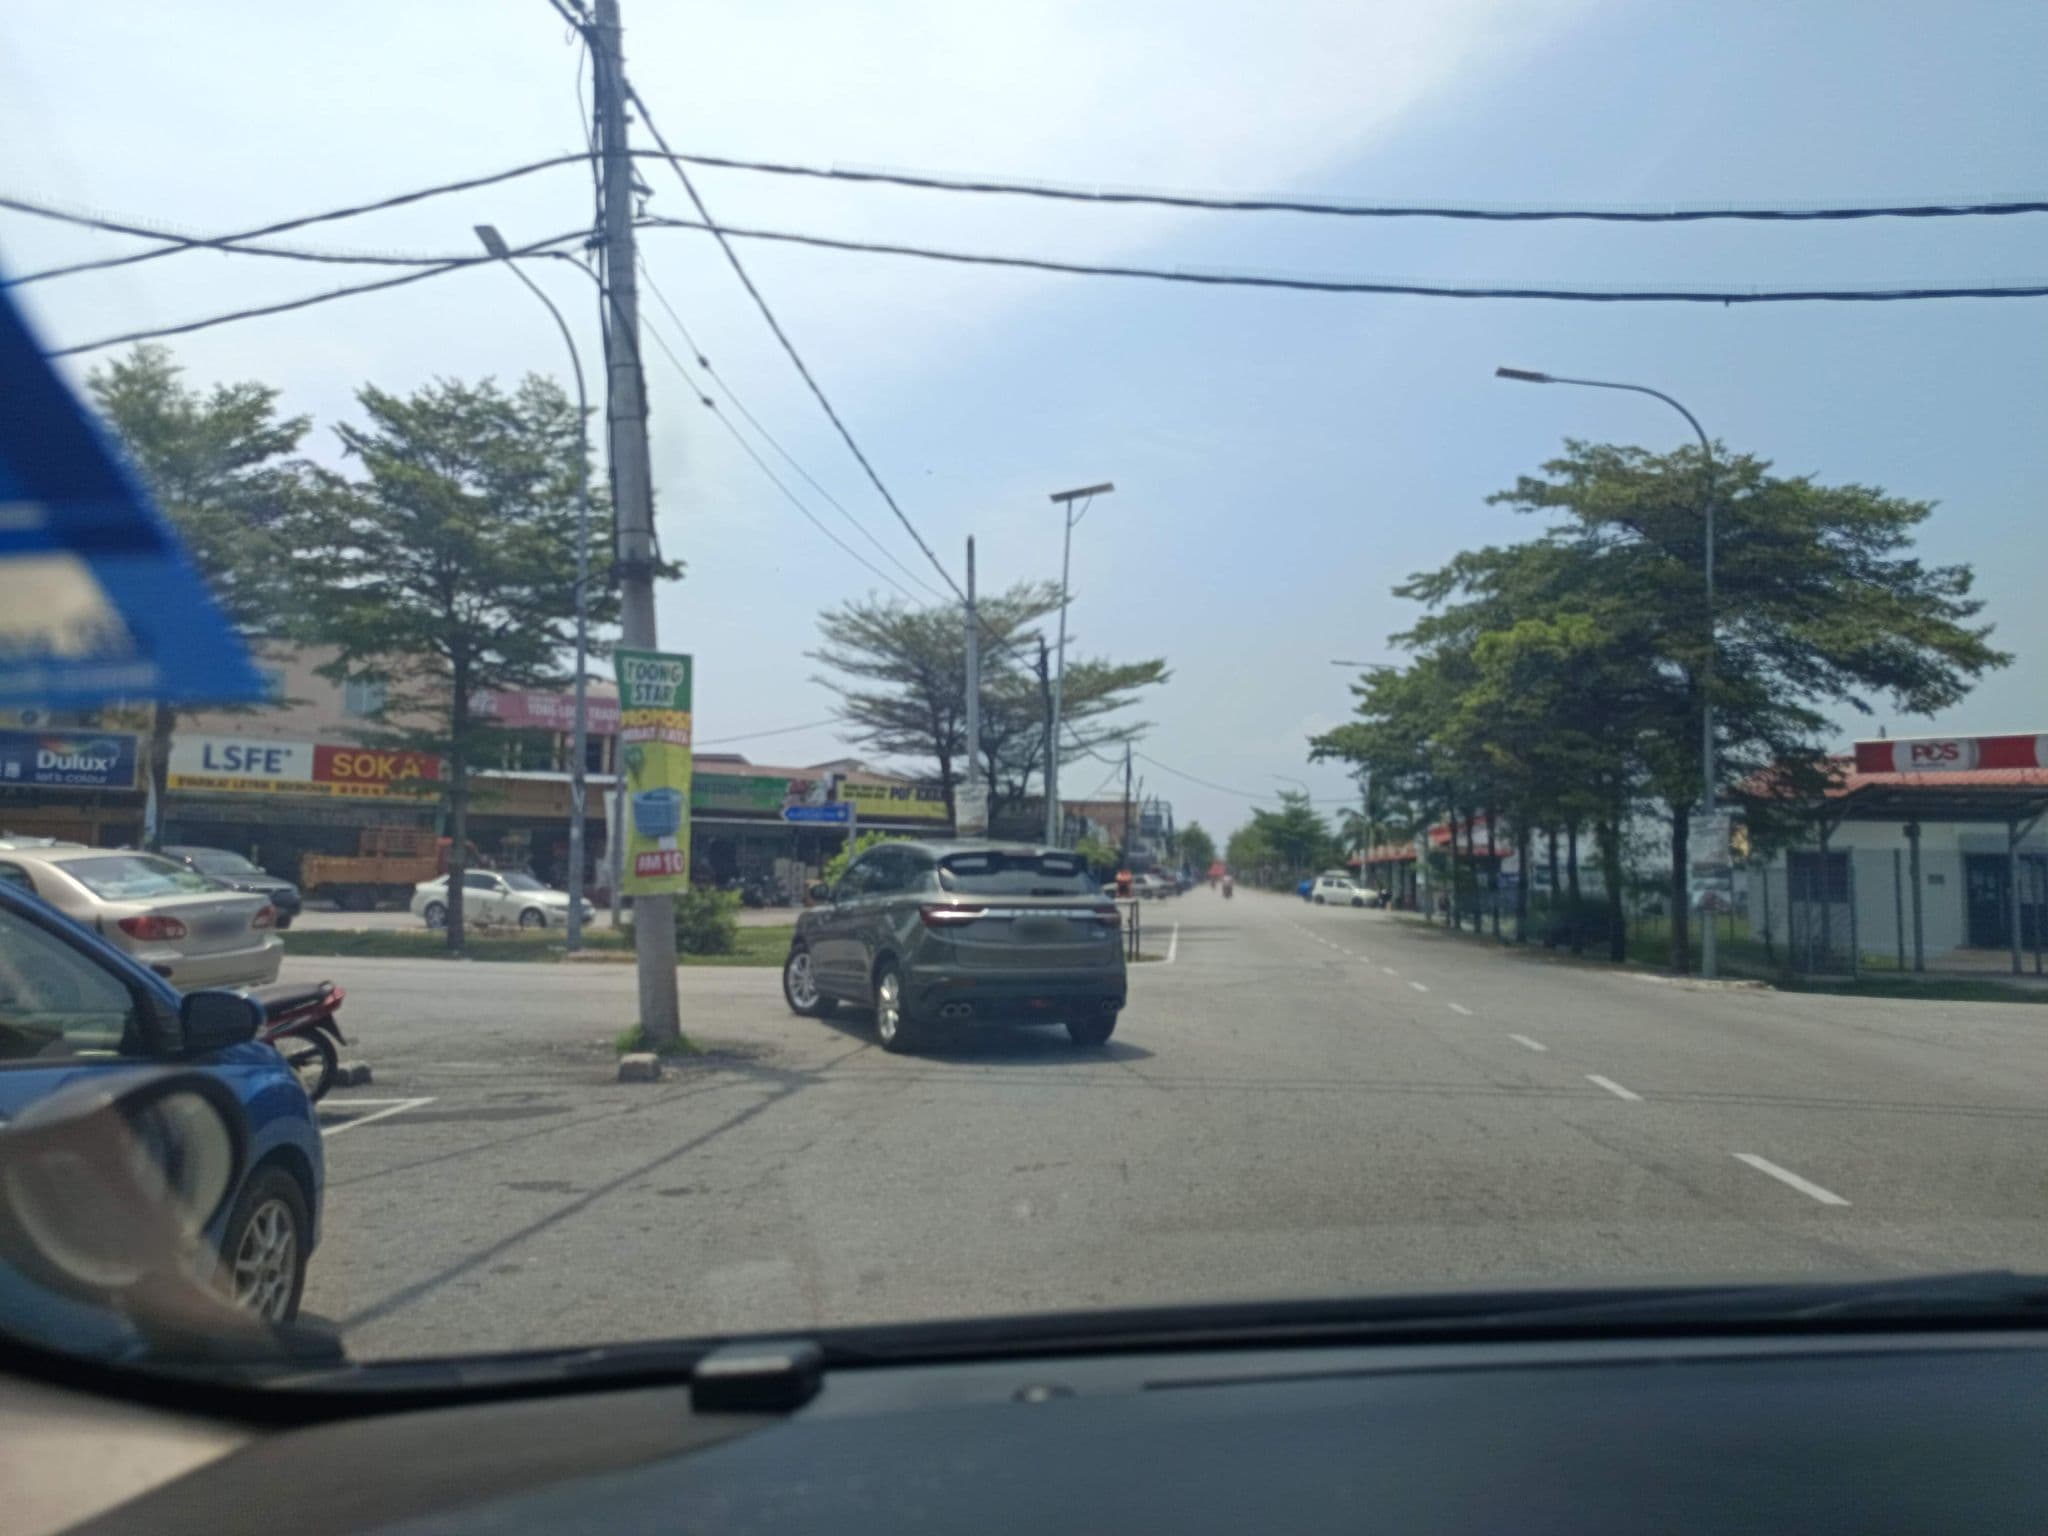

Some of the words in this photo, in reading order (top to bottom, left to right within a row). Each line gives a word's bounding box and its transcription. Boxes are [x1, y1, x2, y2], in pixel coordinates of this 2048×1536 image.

[634, 683, 674, 702] STAR
[36, 749, 108, 772] Dulux
[202, 743, 282, 773] LSFE
[1910, 742, 1960, 762] POS
[331, 752, 421, 779] SOKA
[663, 852, 685, 873] 10
